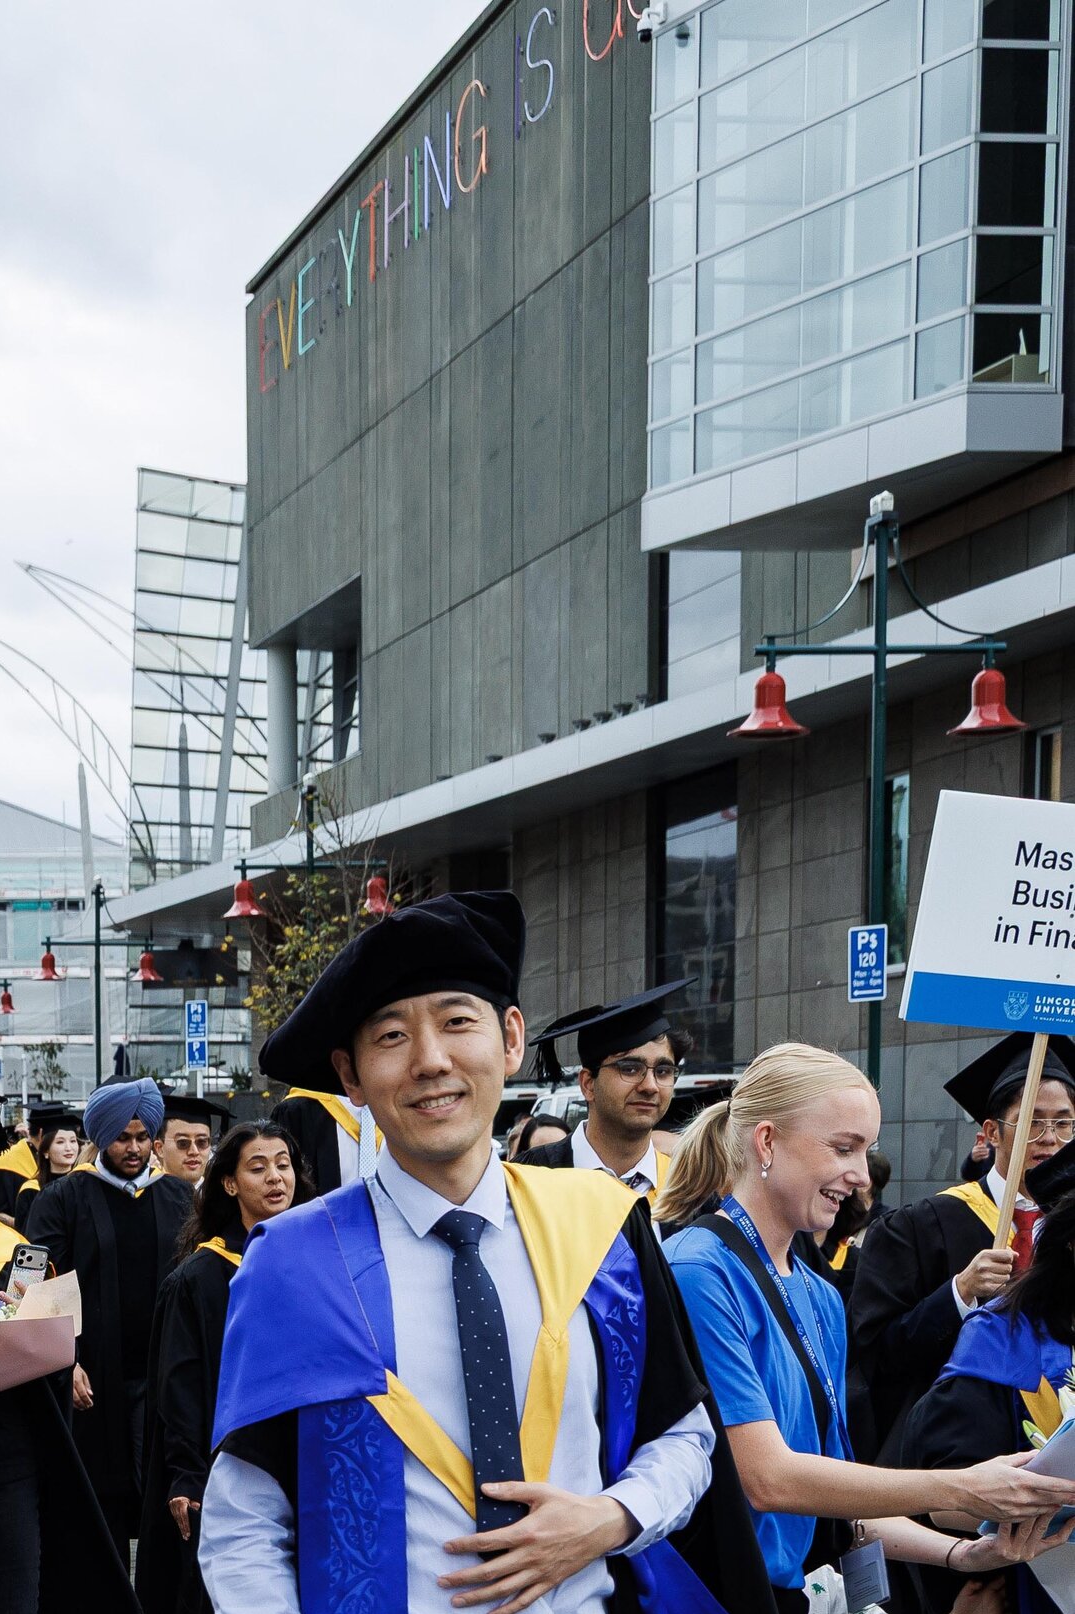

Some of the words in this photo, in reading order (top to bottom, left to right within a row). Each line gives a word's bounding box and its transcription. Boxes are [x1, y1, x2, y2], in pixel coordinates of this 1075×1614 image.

[259, 79, 489, 394] EVERYTHING
[514, 7, 556, 141] IS
[993, 916, 1021, 944] in
[858, 951, 877, 968] 120
